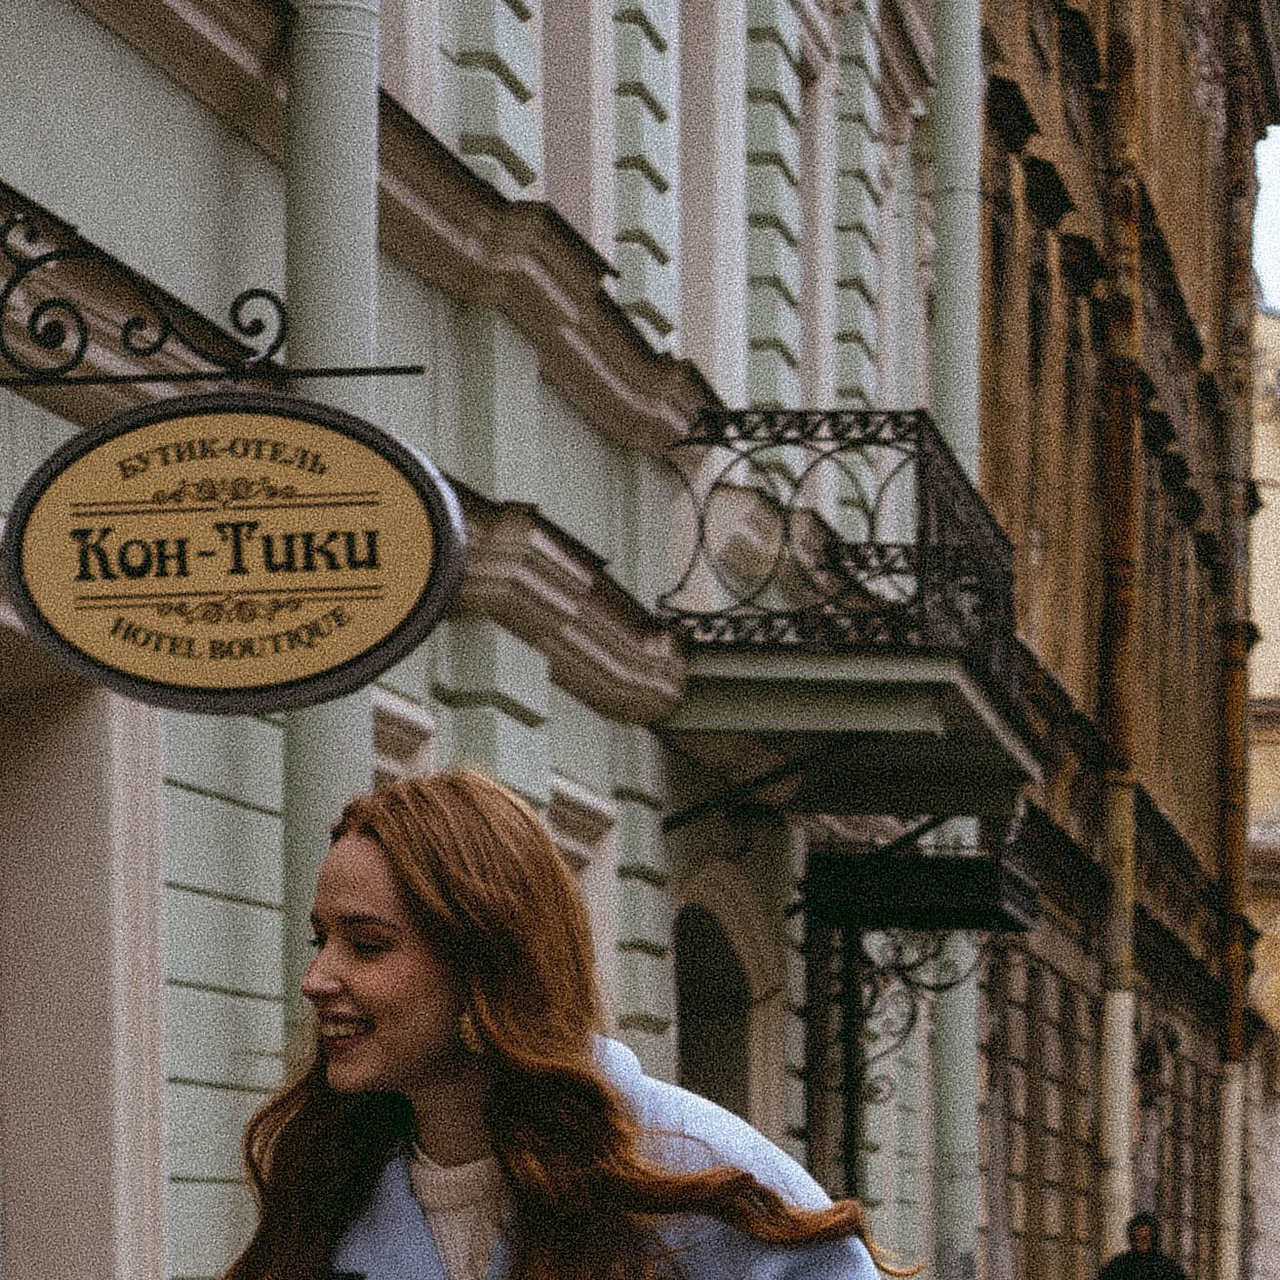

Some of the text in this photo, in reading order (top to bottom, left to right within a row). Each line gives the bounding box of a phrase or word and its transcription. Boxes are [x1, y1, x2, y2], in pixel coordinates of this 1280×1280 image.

[117, 437, 328, 480] БУТИК-ОТЕЛЬ
[70, 520, 381, 582] Кон-Тики
[110, 606, 350, 661] HOTEL BOUTIQUE
